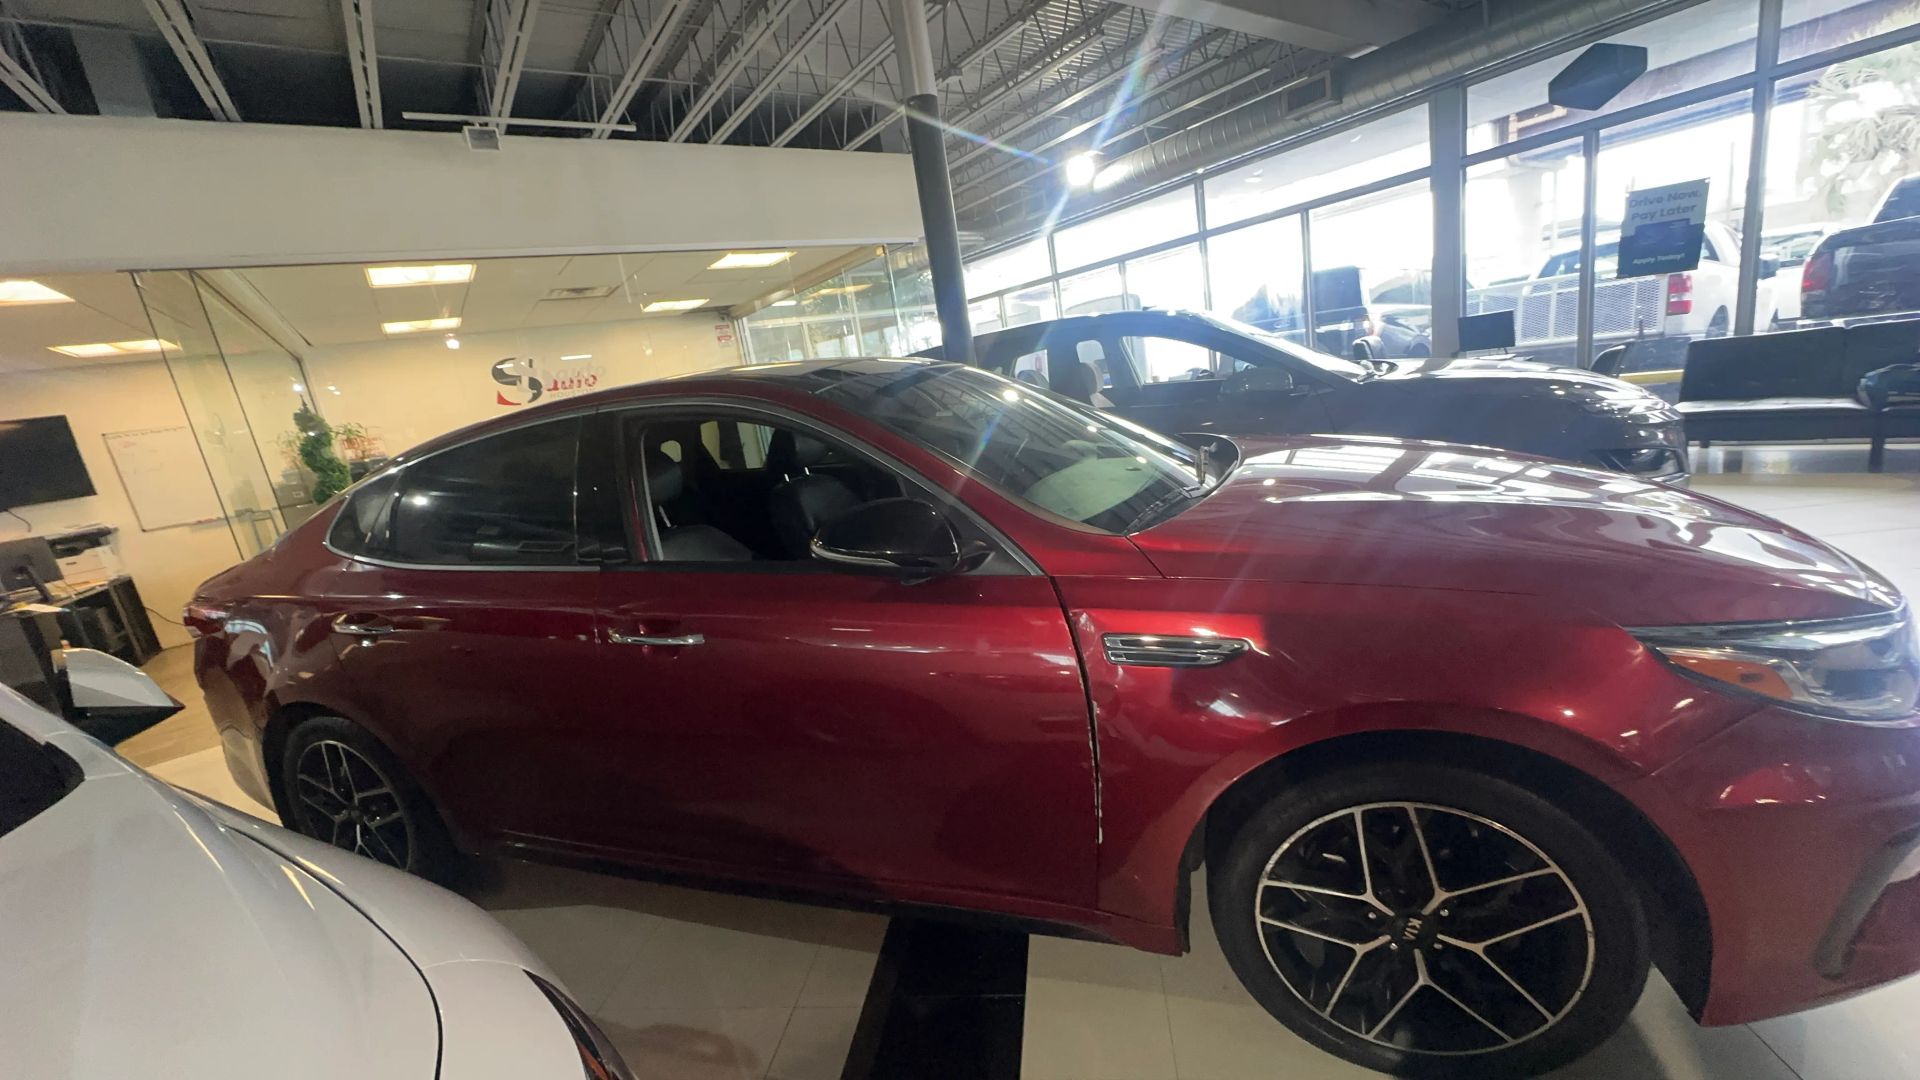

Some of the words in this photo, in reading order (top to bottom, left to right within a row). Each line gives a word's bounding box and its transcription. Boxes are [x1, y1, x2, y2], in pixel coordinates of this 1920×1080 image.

[1629, 195, 1664, 208] Drive
[1631, 209, 1657, 221] Pay
[1659, 204, 1697, 217] Later
[1402, 917, 1422, 940] KIA
